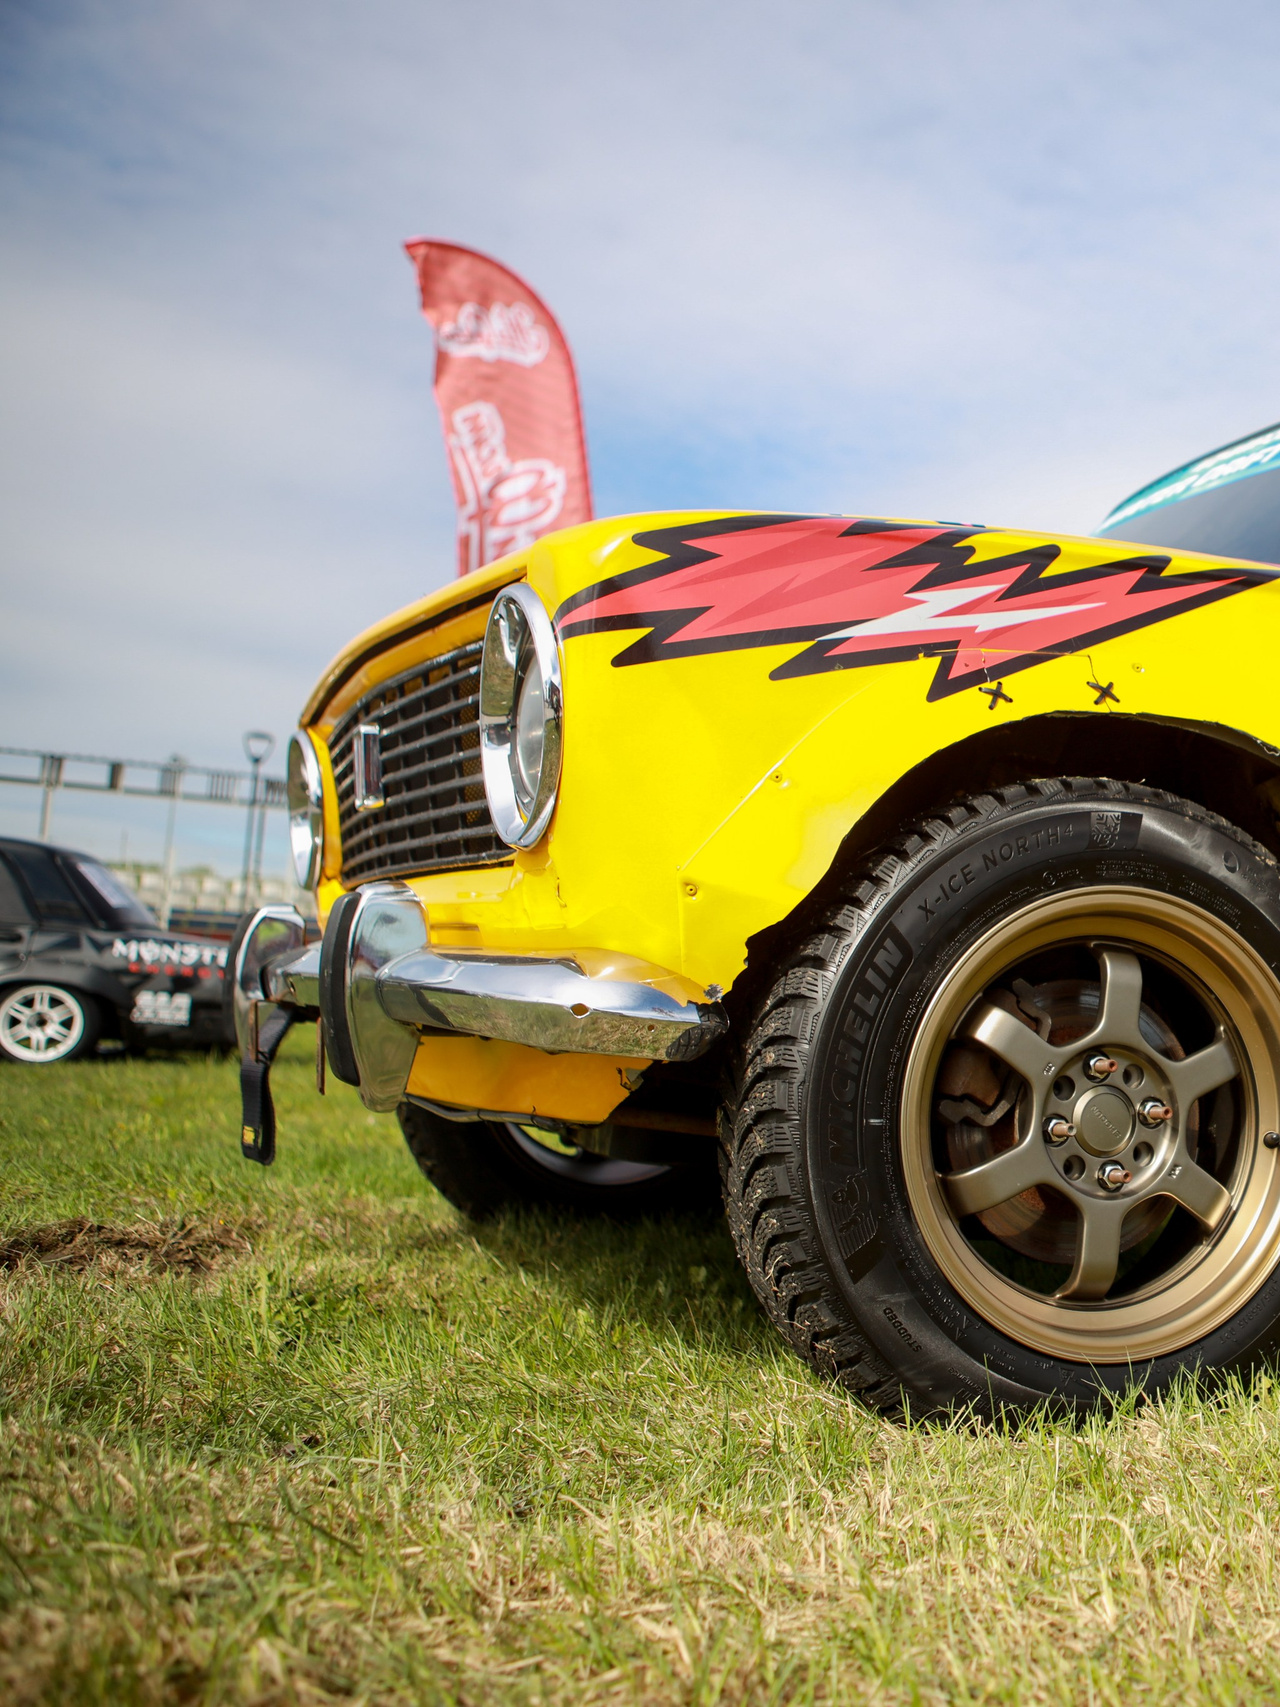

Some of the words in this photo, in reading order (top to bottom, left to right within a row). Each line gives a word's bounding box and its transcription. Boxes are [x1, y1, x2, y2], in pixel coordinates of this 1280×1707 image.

[917, 862, 977, 925] X-ICE
[826, 938, 906, 1169] MICHELIN
[883, 1306, 921, 1353] STUDDED
